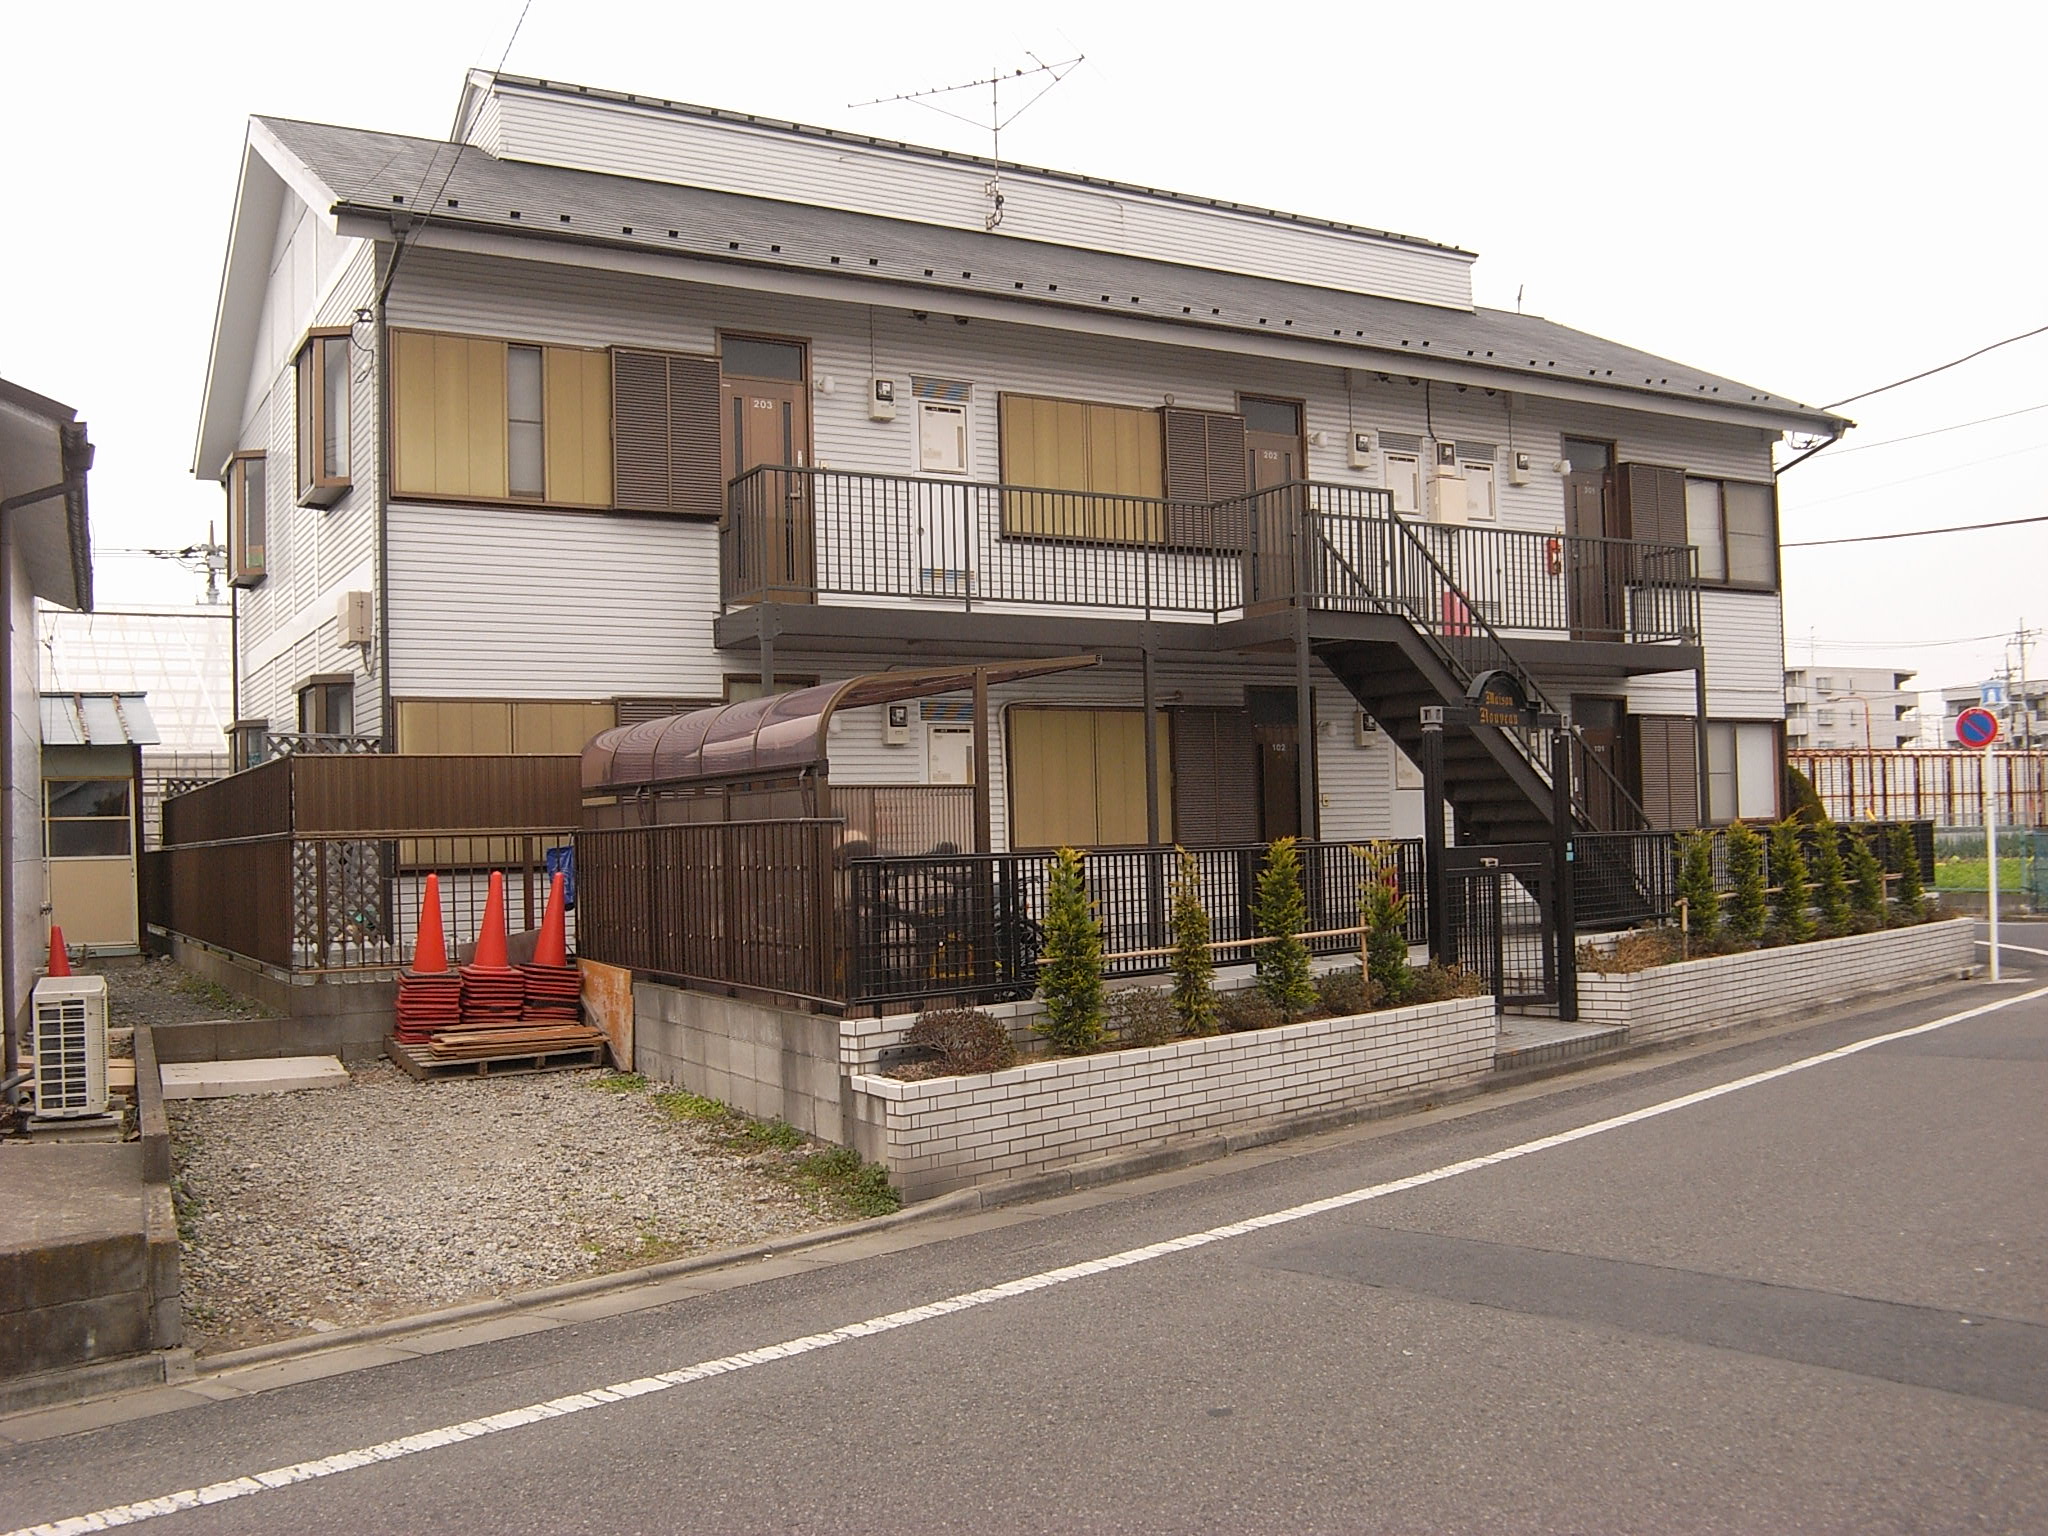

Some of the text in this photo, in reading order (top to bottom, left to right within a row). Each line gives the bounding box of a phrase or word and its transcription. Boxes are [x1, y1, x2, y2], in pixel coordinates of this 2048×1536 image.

[753, 399, 773, 409] 203
[1263, 450, 1278, 460] 202
[1485, 691, 1513, 705] Maison
[1480, 707, 1518, 724] Nouveau
[1272, 743, 1286, 752] 102
